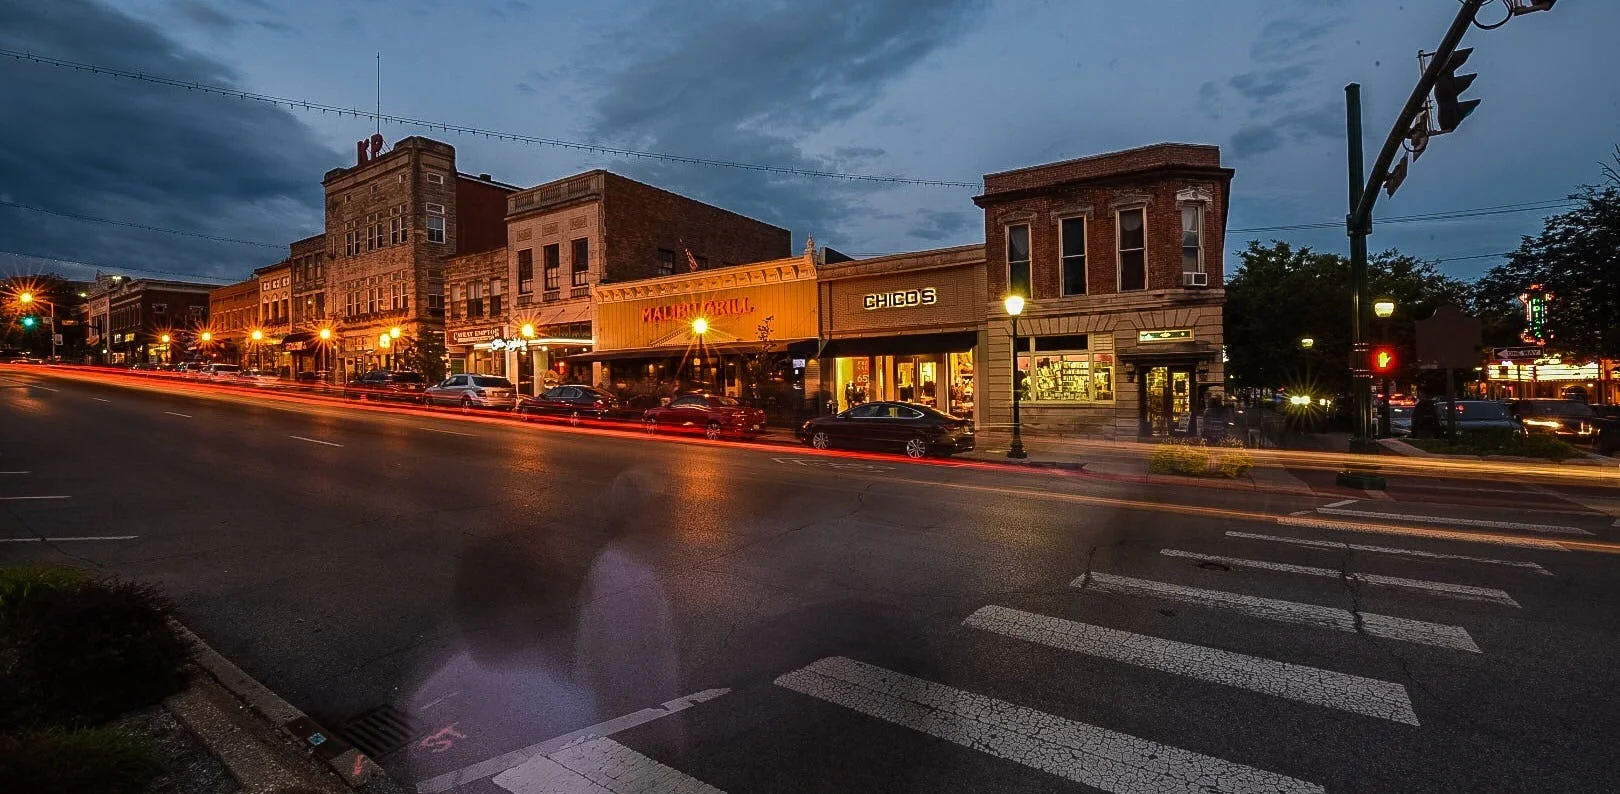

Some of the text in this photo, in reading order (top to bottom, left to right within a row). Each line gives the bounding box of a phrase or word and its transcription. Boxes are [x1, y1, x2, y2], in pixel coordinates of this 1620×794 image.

[642, 297, 755, 321] MALIBU GRILL
[863, 287, 936, 309] CHICO'S
